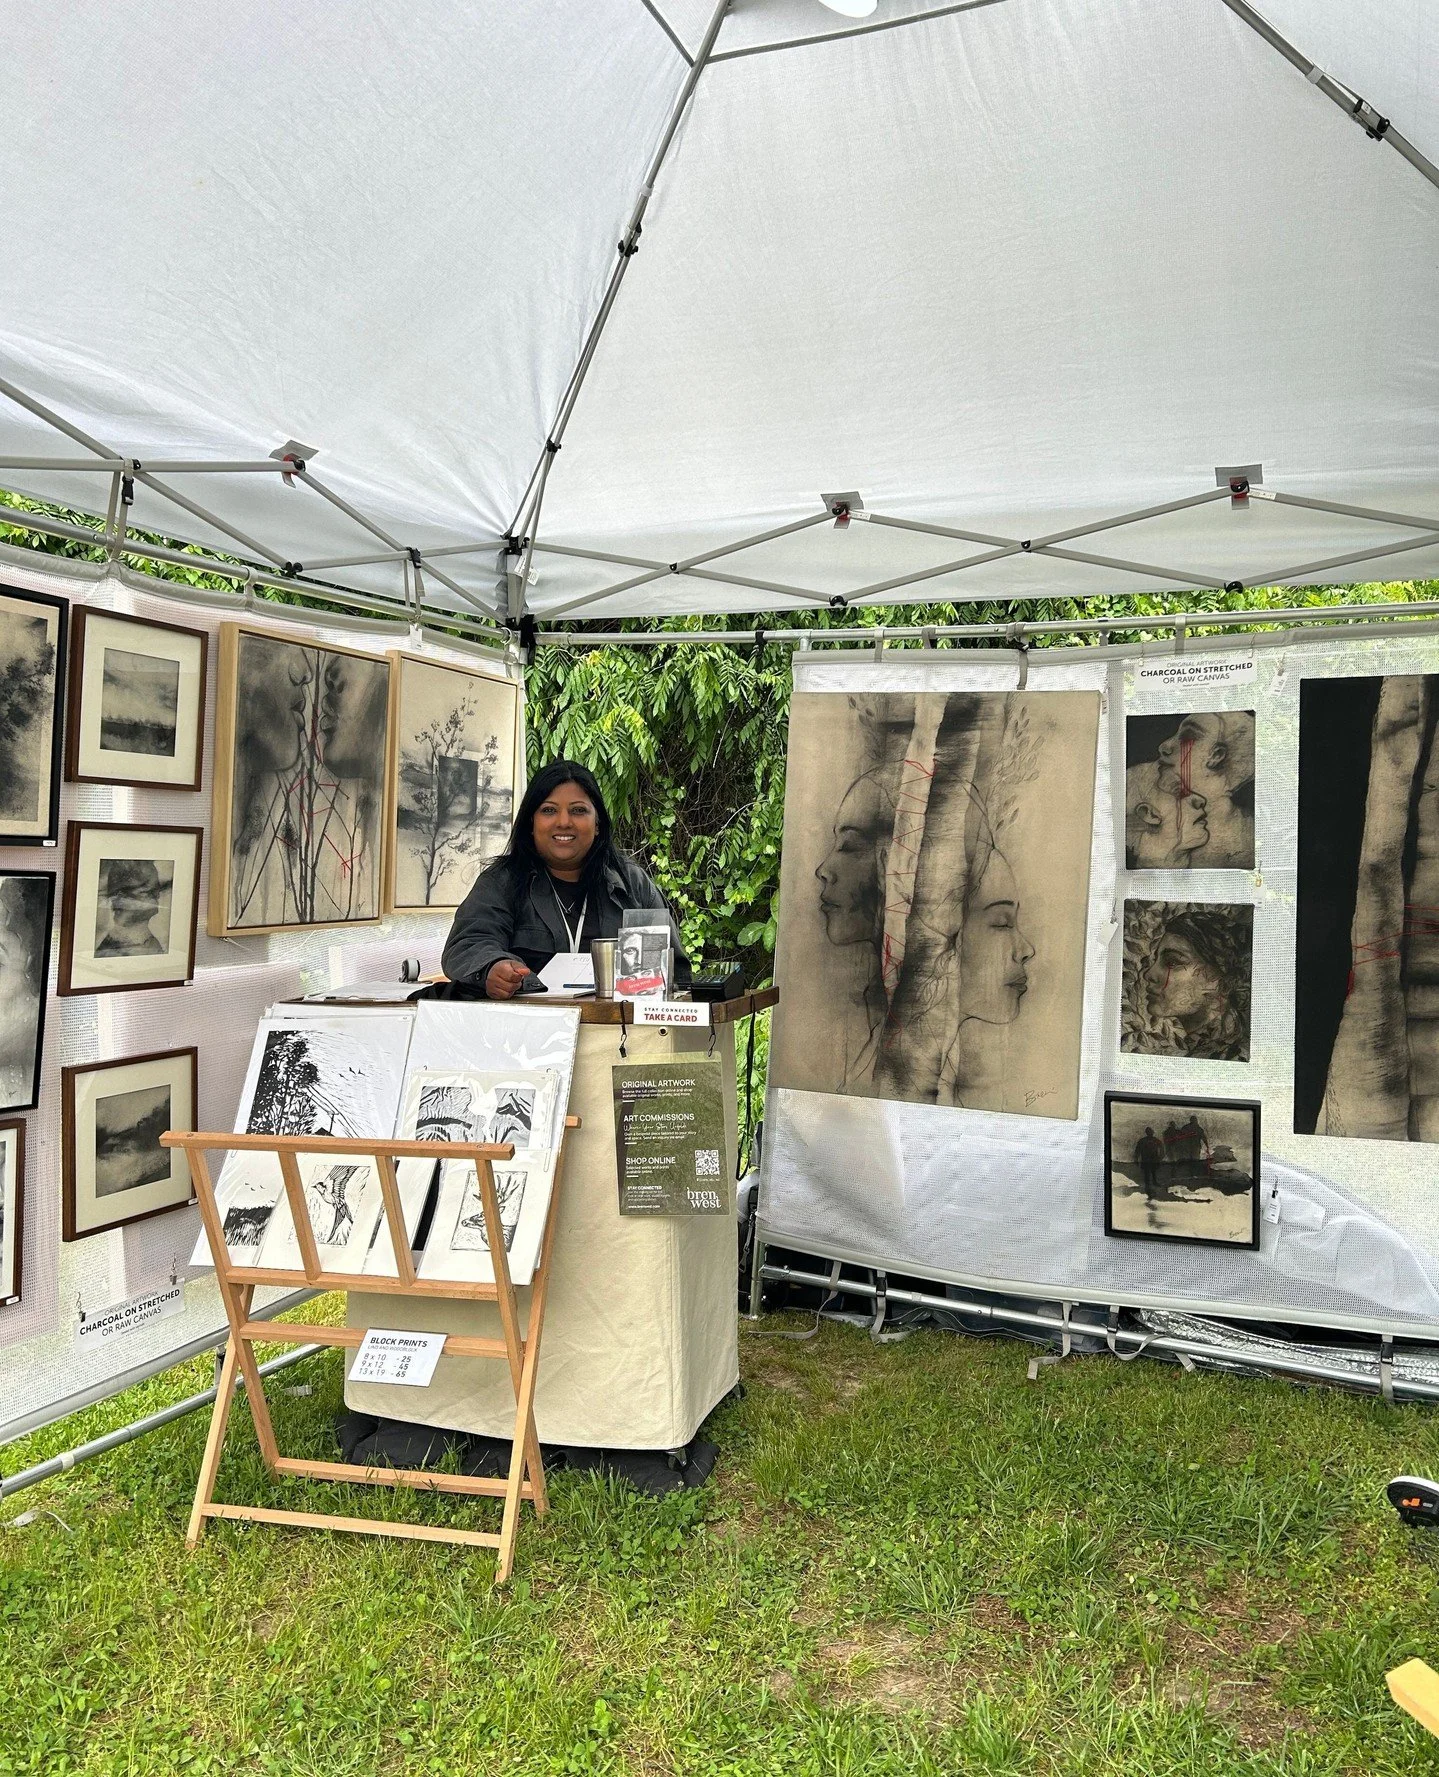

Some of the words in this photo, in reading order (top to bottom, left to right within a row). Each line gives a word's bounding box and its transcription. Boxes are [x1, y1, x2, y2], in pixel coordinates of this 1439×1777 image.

[1140, 668, 1187, 676] CHARCOAL
[1203, 662, 1252, 673] STRETCHED
[1197, 673, 1230, 682] CANVAS
[644, 1013, 665, 1021] TAKE
[622, 1080, 657, 1088] ORIGINAL
[626, 1157, 646, 1165] SHOP
[691, 1196, 721, 1208] west
[104, 1302, 131, 1316] ORIGINAL
[132, 1291, 158, 1304] ARTWORK
[80, 1313, 124, 1335] CHARCOAL
[124, 1306, 137, 1317] ON
[138, 1289, 180, 1311] STRETCHED
[102, 1326, 114, 1336] OR
[115, 1318, 132, 1331] RAW
[133, 1306, 161, 1323] CANVAS
[370, 1337, 397, 1345] BLOCK
[398, 1339, 427, 1347] PRINTS
[376, 1369, 385, 1377] 19
